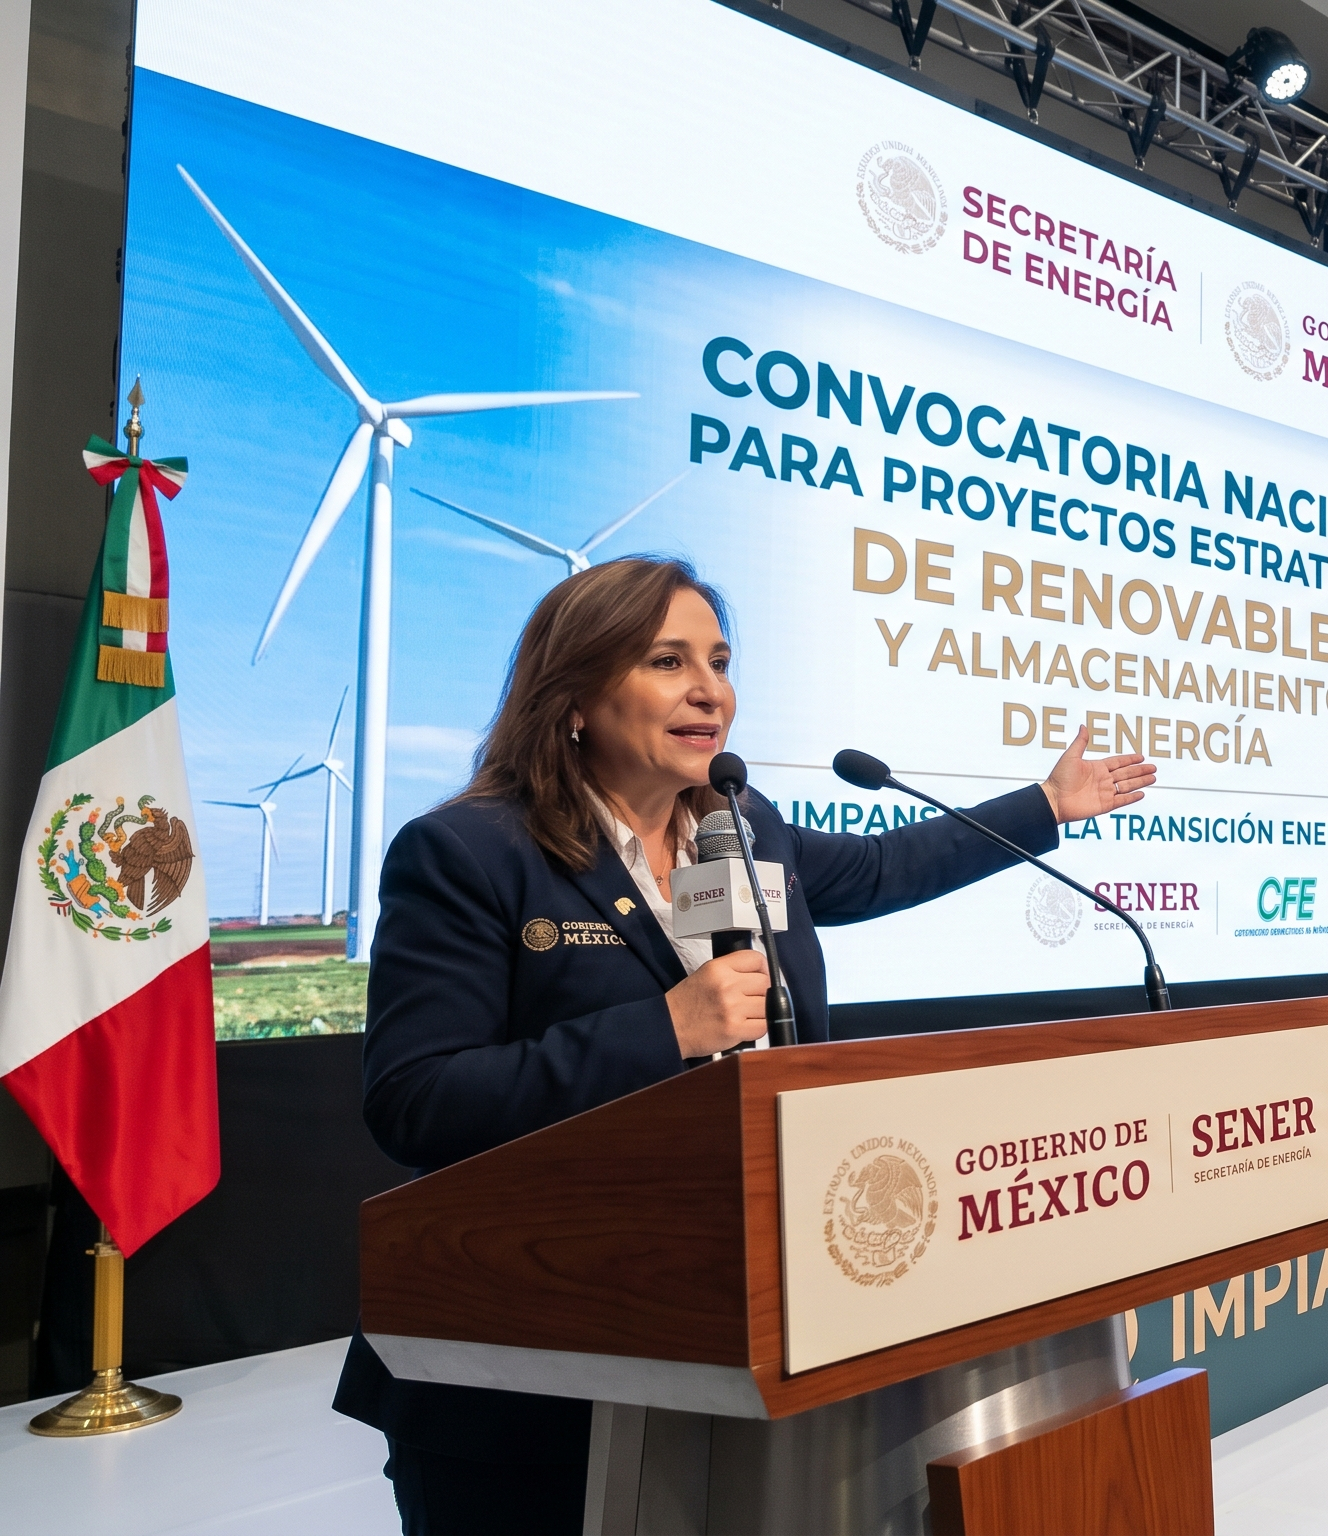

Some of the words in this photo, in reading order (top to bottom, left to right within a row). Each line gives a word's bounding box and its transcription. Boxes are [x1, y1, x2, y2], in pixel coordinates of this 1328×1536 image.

[962, 185, 1178, 292] SECRETARÍA
[963, 229, 1012, 272] DE
[1025, 252, 1173, 332] ENERGÍA
[701, 335, 1208, 510] CONVOCATORIA
[689, 412, 862, 498] PARA
[883, 460, 1175, 560] PROYECTOS
[852, 527, 954, 605] DE
[874, 618, 912, 667] Y
[1002, 701, 1067, 750] DE
[1085, 710, 1272, 767] ENERGÍA
[1110, 811, 1274, 845] TRANSICIÓN
[693, 887, 725, 902] SENER
[1094, 881, 1200, 912] SENER
[1147, 921, 1158, 929] DE
[1160, 919, 1194, 929] ENERGÍA
[1257, 876, 1317, 922] CFE
[955, 1126, 1107, 1176] GOBIERNO
[1115, 1119, 1148, 1144] DE
[1191, 1096, 1317, 1157] SENER
[1194, 1158, 1255, 1183] SECRETARÍA
[1257, 1156, 1270, 1169] DE
[1272, 1146, 1312, 1166] ENERGÍA
[958, 1159, 1150, 1241] MÉXICO
